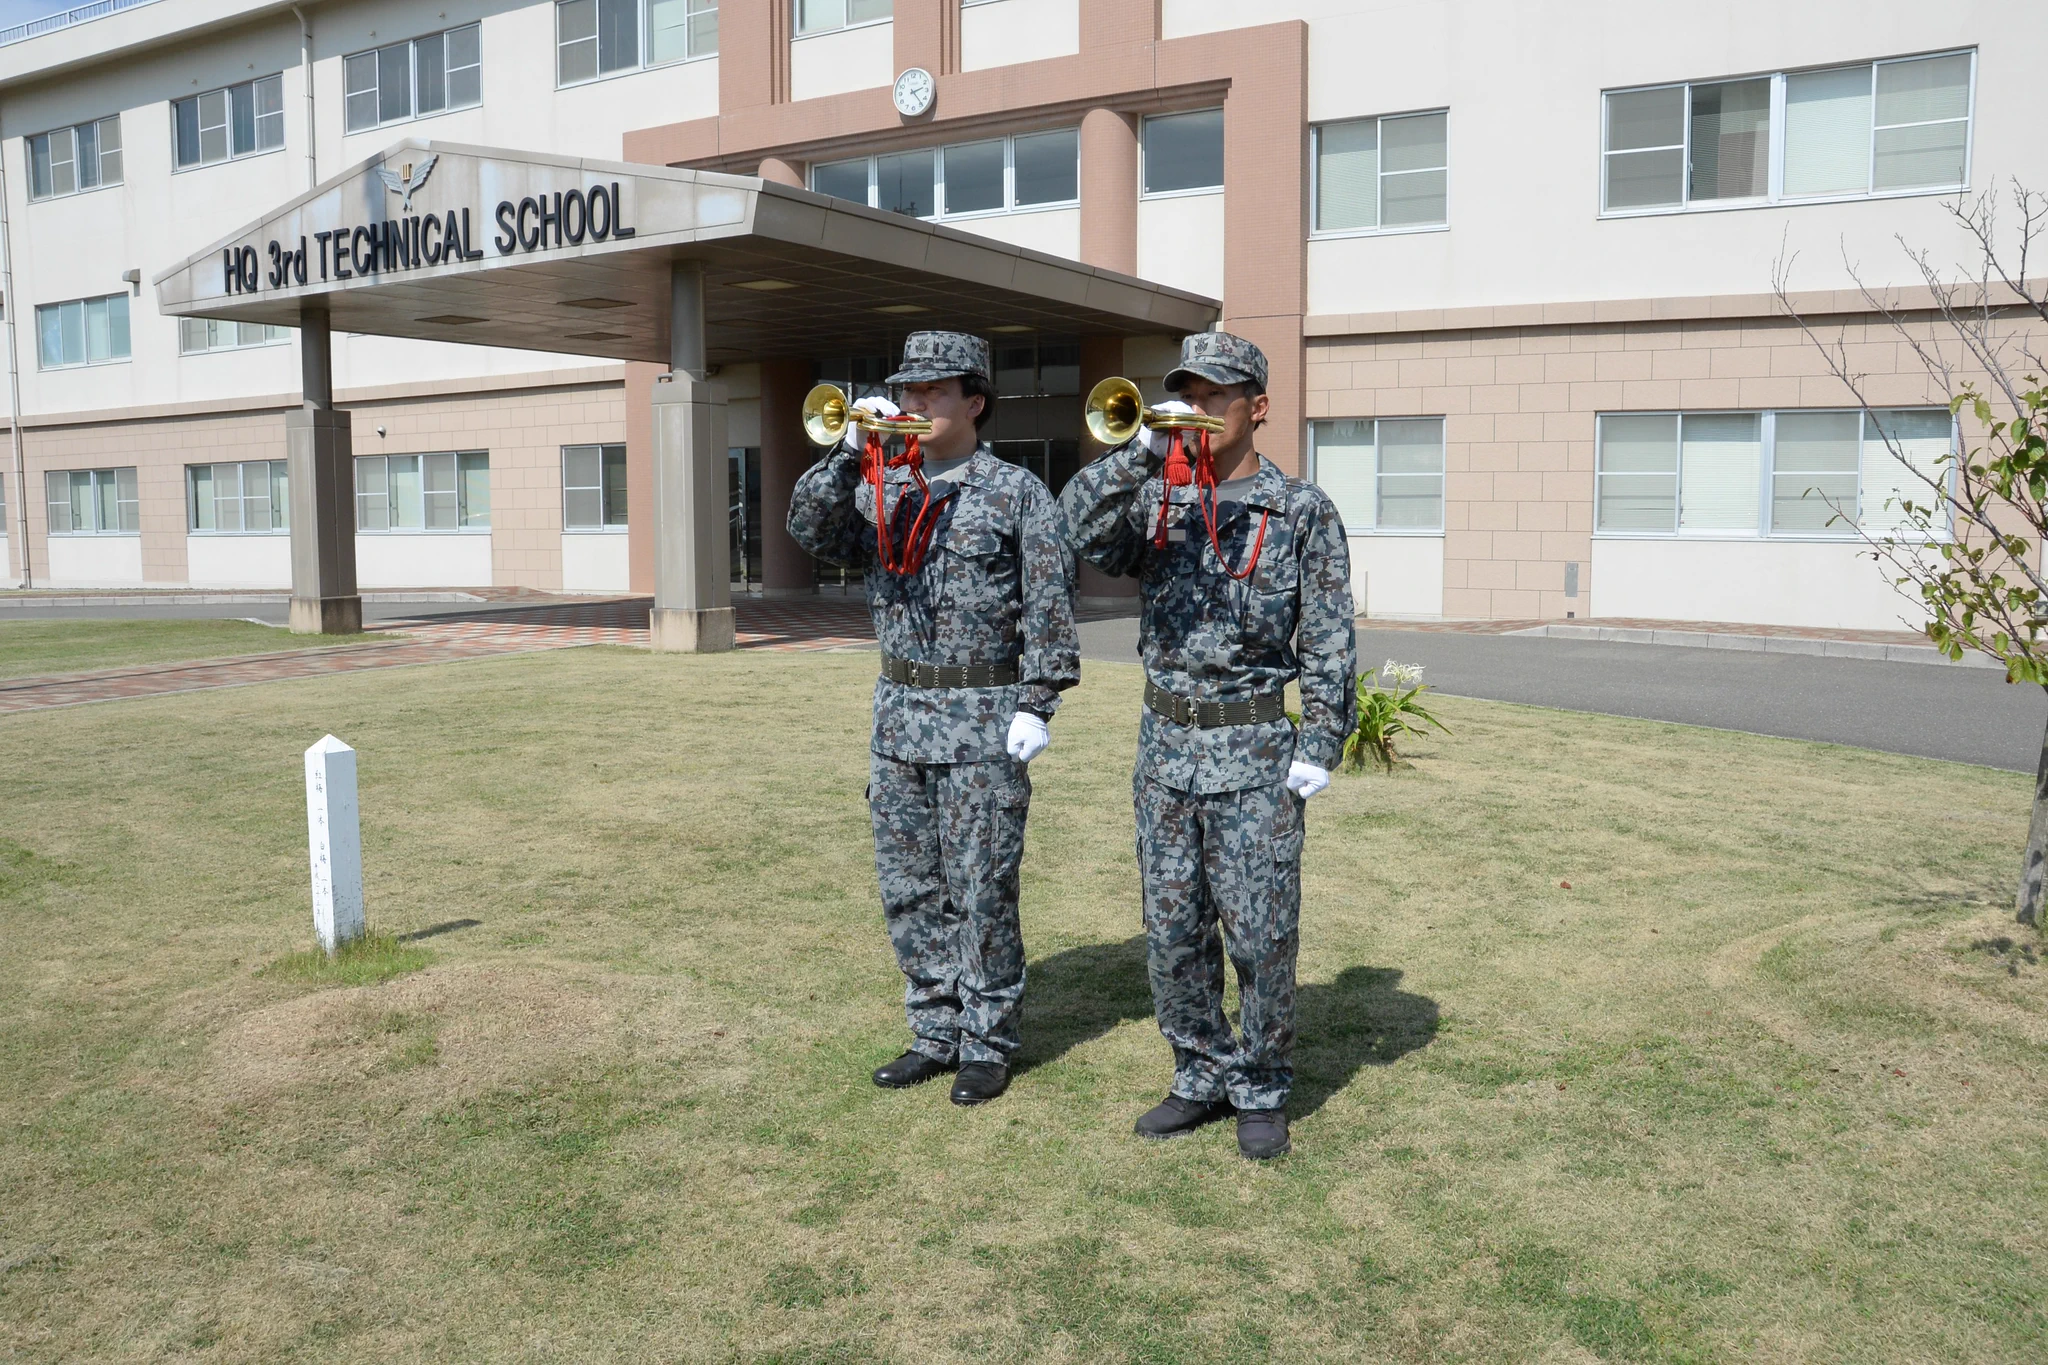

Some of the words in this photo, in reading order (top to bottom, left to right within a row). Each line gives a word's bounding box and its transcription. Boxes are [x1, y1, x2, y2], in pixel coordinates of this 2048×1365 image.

[223, 245, 258, 294] HQ
[268, 235, 308, 290] 3rd
[314, 207, 483, 281] TECHNICAL
[494, 182, 636, 256] SCHOOL
